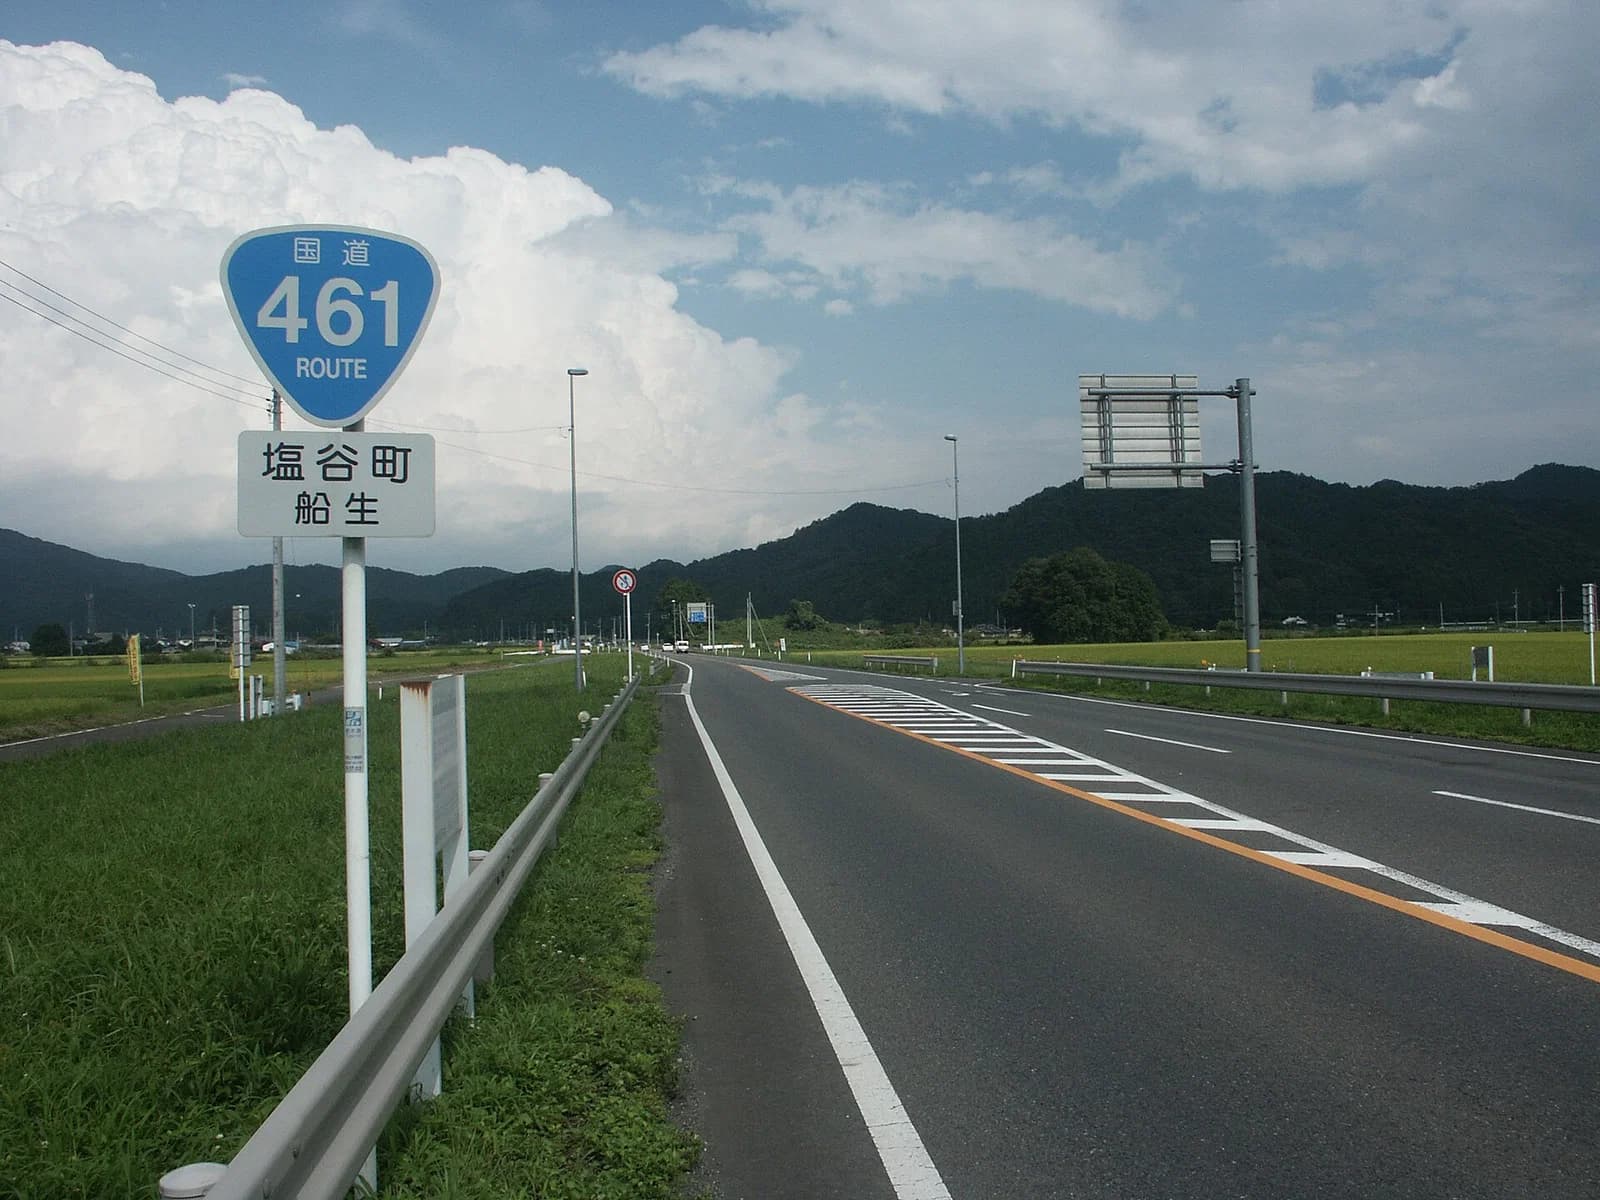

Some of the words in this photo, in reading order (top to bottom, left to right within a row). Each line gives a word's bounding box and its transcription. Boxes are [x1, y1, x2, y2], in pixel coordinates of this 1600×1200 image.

[294, 237, 371, 266] 国道
[256, 275, 399, 347] 461
[296, 357, 368, 379] ROUTE
[262, 442, 412, 483] 塩谷町
[295, 491, 379, 526] 船生
